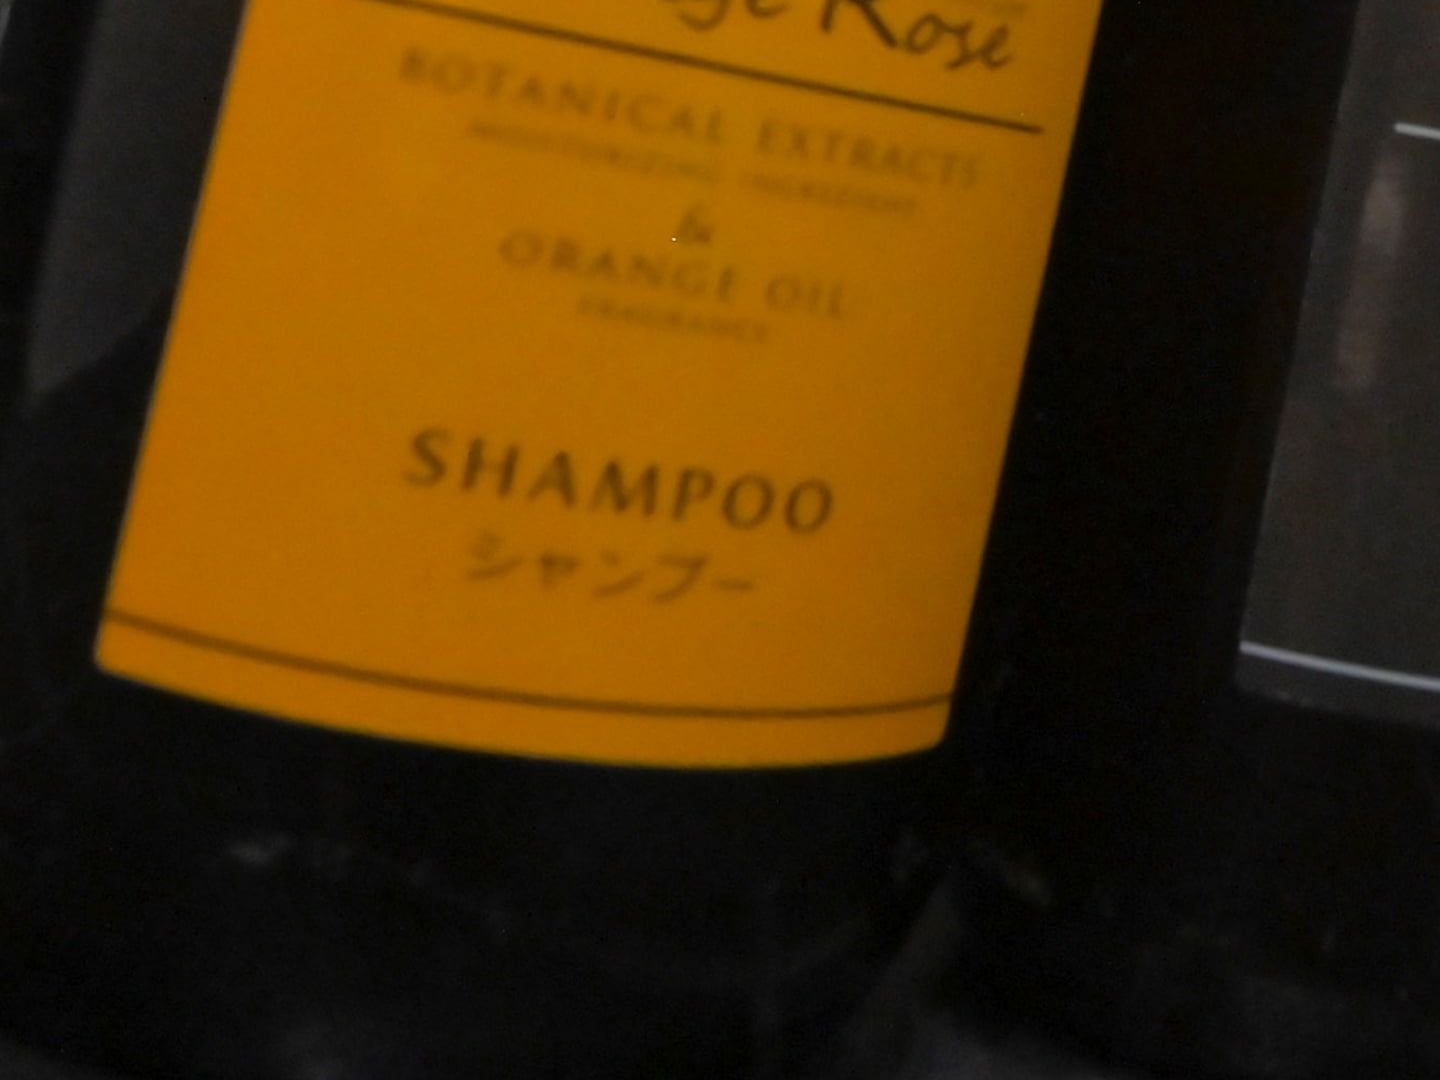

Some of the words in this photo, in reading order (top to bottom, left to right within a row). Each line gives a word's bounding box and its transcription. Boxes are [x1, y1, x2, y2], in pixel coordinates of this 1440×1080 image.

[400, 44, 726, 147] BOTANICAL
[497, 228, 738, 305] ORANGE
[763, 271, 848, 321] OIL
[400, 424, 836, 537] SHAMPOO
